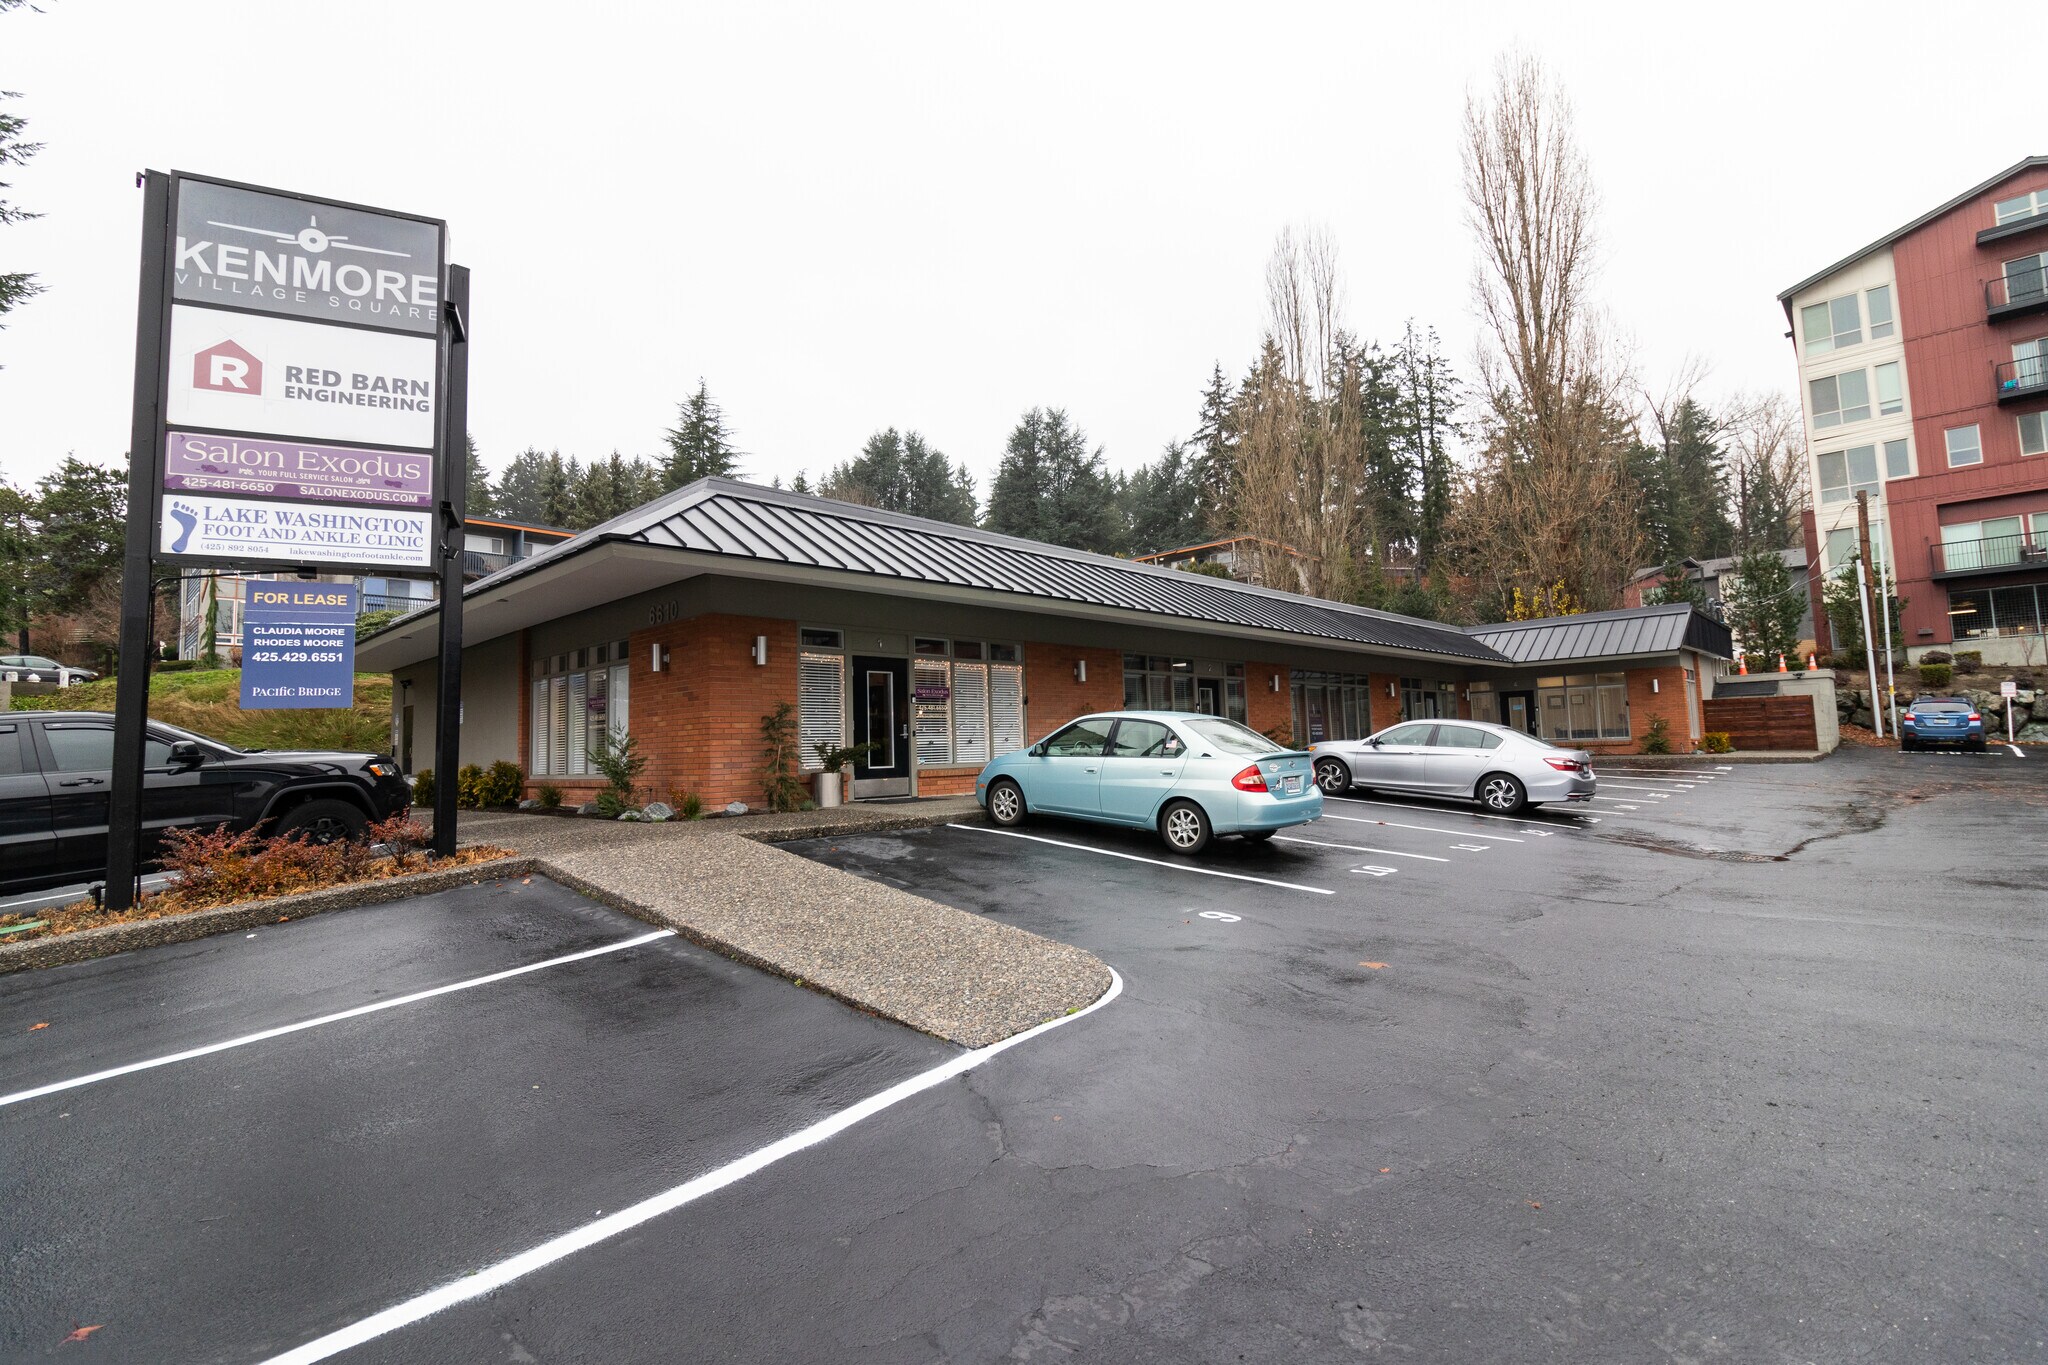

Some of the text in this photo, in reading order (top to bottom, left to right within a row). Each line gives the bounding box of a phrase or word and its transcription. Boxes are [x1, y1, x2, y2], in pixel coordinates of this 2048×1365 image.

[175, 235, 437, 306] KENMORE
[174, 271, 438, 321] VILLAGE SQUARE
[285, 365, 430, 397] RED BARN
[285, 385, 430, 413] ENGINEERING
[182, 440, 421, 480] Salon Exodus
[258, 469, 353, 483] YOUR FULL SERVICE SALON
[181, 477, 274, 492] 425-481-6650
[300, 486, 418, 503] SALONEXODUS.COM
[203, 506, 423, 534] LAKE WASHINGTON
[203, 523, 424, 548] FOOT AND ANKLE CLINIC
[200, 543, 225, 551] (425)
[228, 544, 244, 552] 892
[289, 548, 423, 561] lakewashingtonfootankle.com
[253, 592, 348, 606] FOR LEASE
[649, 600, 679, 625] 6610
[253, 627, 345, 636] CLAUDIA MOORE
[253, 638, 344, 647] RHODES MOORE
[252, 651, 343, 662] 425.429.6551
[298, 686, 342, 697] BRIDGE
